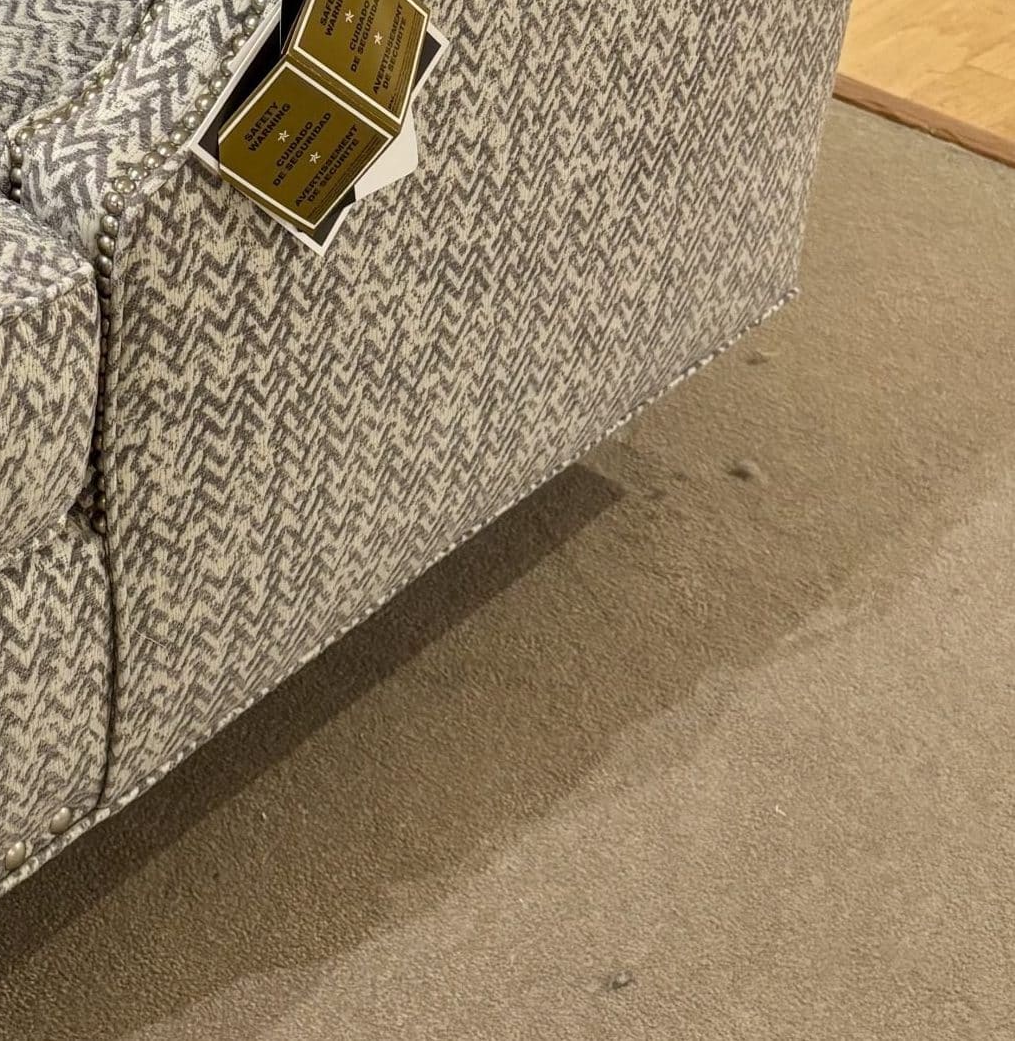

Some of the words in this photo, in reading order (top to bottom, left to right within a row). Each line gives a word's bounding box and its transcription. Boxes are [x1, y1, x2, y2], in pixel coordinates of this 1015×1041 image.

[349, 0, 370, 51] CUIDADO
[372, 2, 403, 95] AVERTISSEMENT
[350, 55, 361, 73] DE
[381, 73, 391, 90] DE
[244, 101, 278, 142] SAFETY
[248, 103, 291, 151] WARNING
[276, 121, 313, 167] CUIDADO
[272, 171, 286, 187] DE
[285, 112, 331, 171] SEGURIDAD
[295, 124, 358, 207] AVERTISSEMENT
[306, 188, 319, 202] DE
